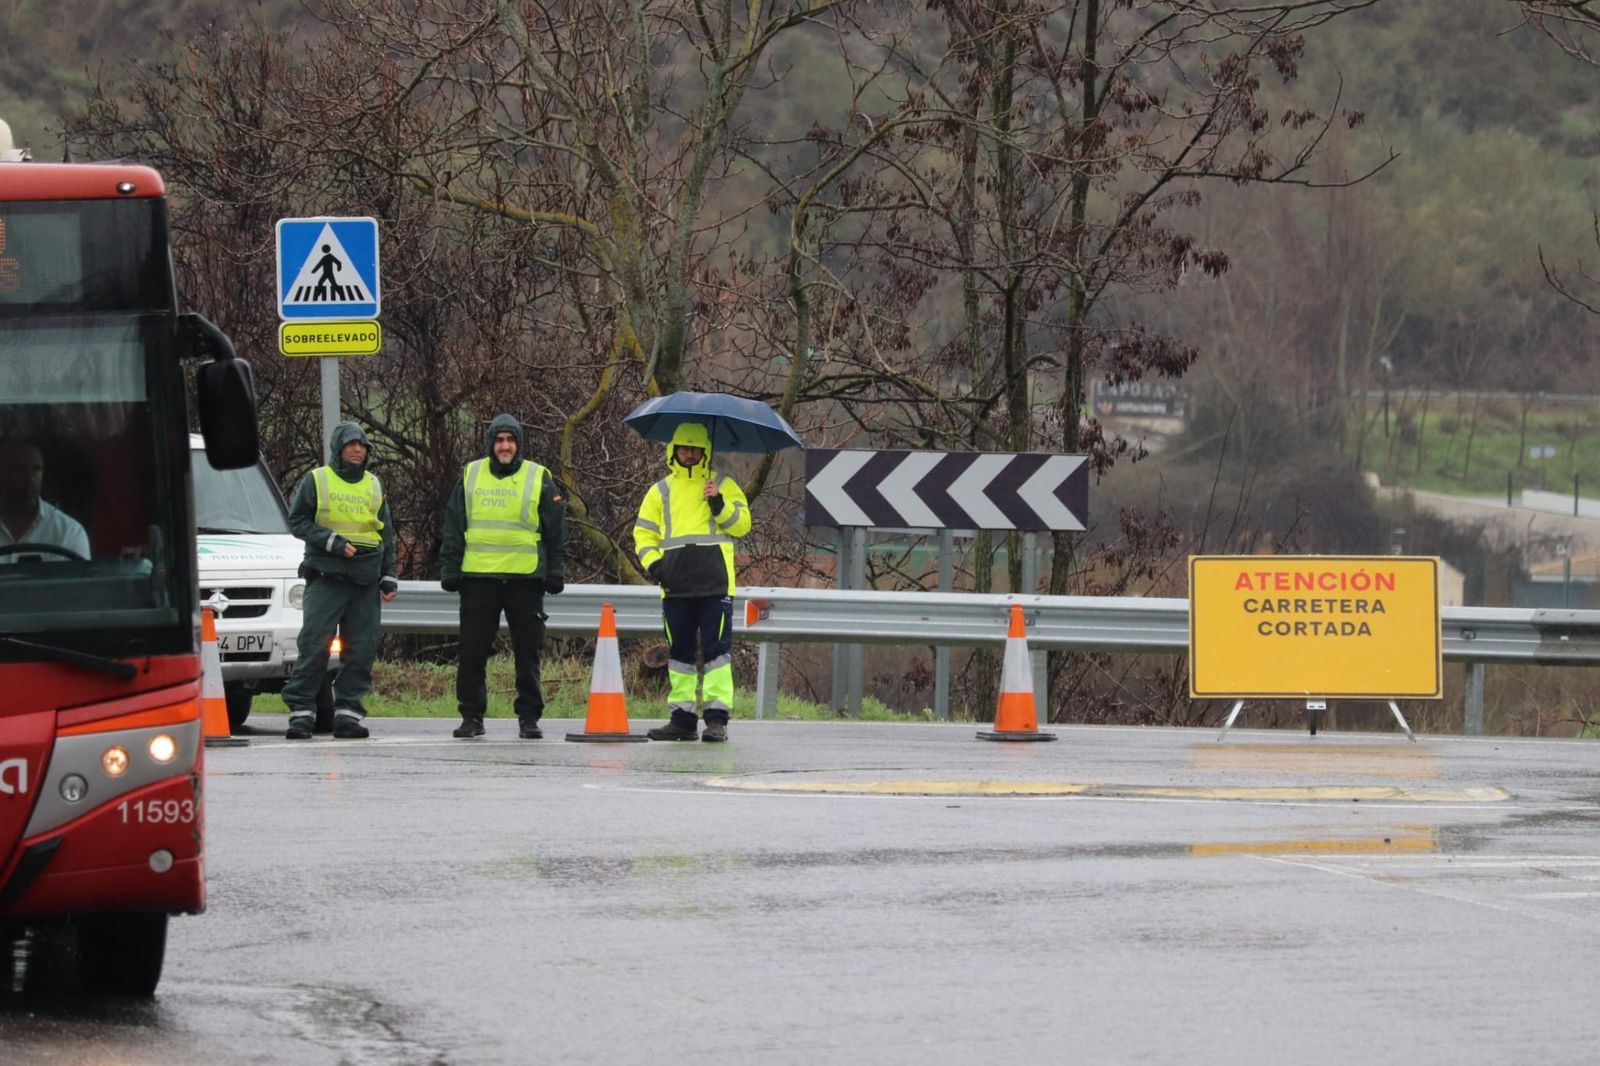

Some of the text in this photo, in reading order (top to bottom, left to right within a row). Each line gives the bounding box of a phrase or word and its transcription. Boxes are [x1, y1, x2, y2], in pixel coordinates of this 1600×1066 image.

[285, 333, 376, 344] SOBREELEVADO
[475, 487, 518, 497] GUARDIA
[338, 503, 365, 514] CIVIL
[481, 498, 507, 508] CIVIL
[1234, 568, 1396, 591] ATENCIÓN
[1243, 598, 1386, 614] CARRETERA
[1257, 620, 1372, 637] CORTADA
[237, 635, 266, 651] DPV
[117, 799, 195, 824] 11593
